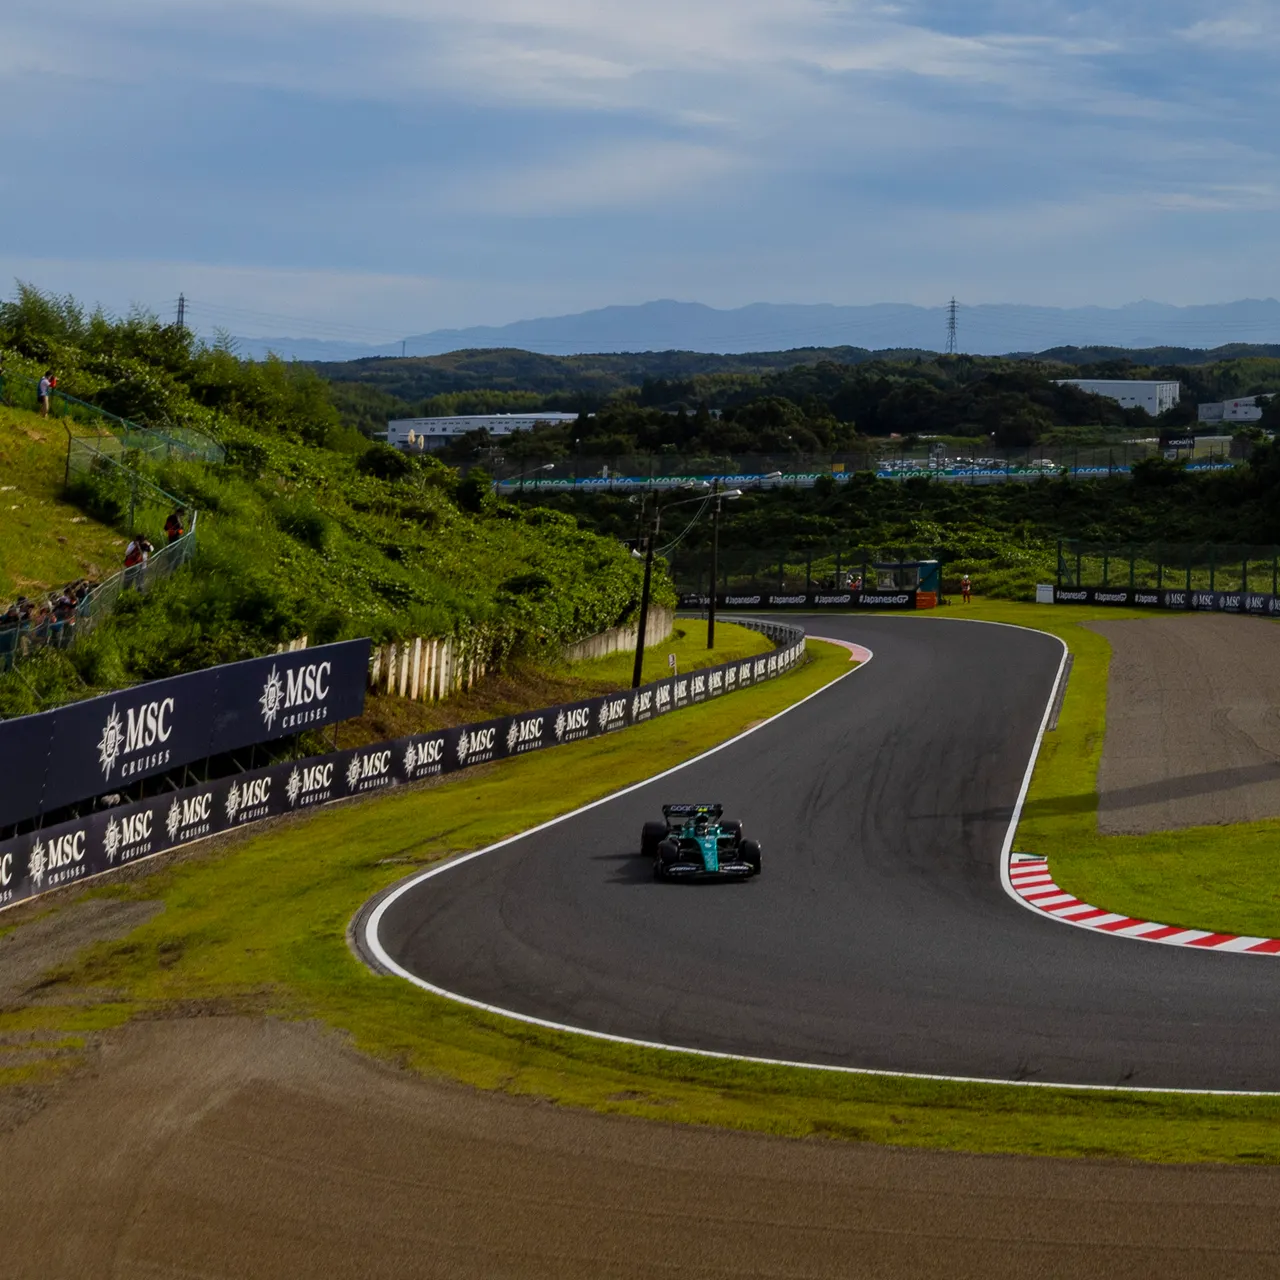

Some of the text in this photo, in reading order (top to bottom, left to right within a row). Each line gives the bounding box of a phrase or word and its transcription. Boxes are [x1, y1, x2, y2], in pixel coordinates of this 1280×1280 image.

[859, 595, 909, 604] #JapaneseGP
[1171, 594, 1186, 604] MSC
[1199, 594, 1213, 605] MSC
[1226, 596, 1240, 607] MSC
[1251, 597, 1264, 608] MSC
[284, 661, 332, 708] MSC
[282, 706, 328, 729] CRUISES
[567, 707, 590, 731] MSC
[609, 699, 627, 721] MSC
[125, 698, 175, 754] MSC
[518, 717, 544, 742] MSC
[417, 738, 444, 766] MSC
[469, 727, 496, 753] MSC
[122, 749, 171, 777] CRUISES
[361, 750, 391, 779] MSC
[302, 762, 334, 794] MSC
[240, 776, 272, 809] MSC
[181, 793, 212, 827] MSC
[121, 810, 153, 847] MSC
[48, 830, 86, 871] MSC
[48, 864, 86, 886] CRUISES
